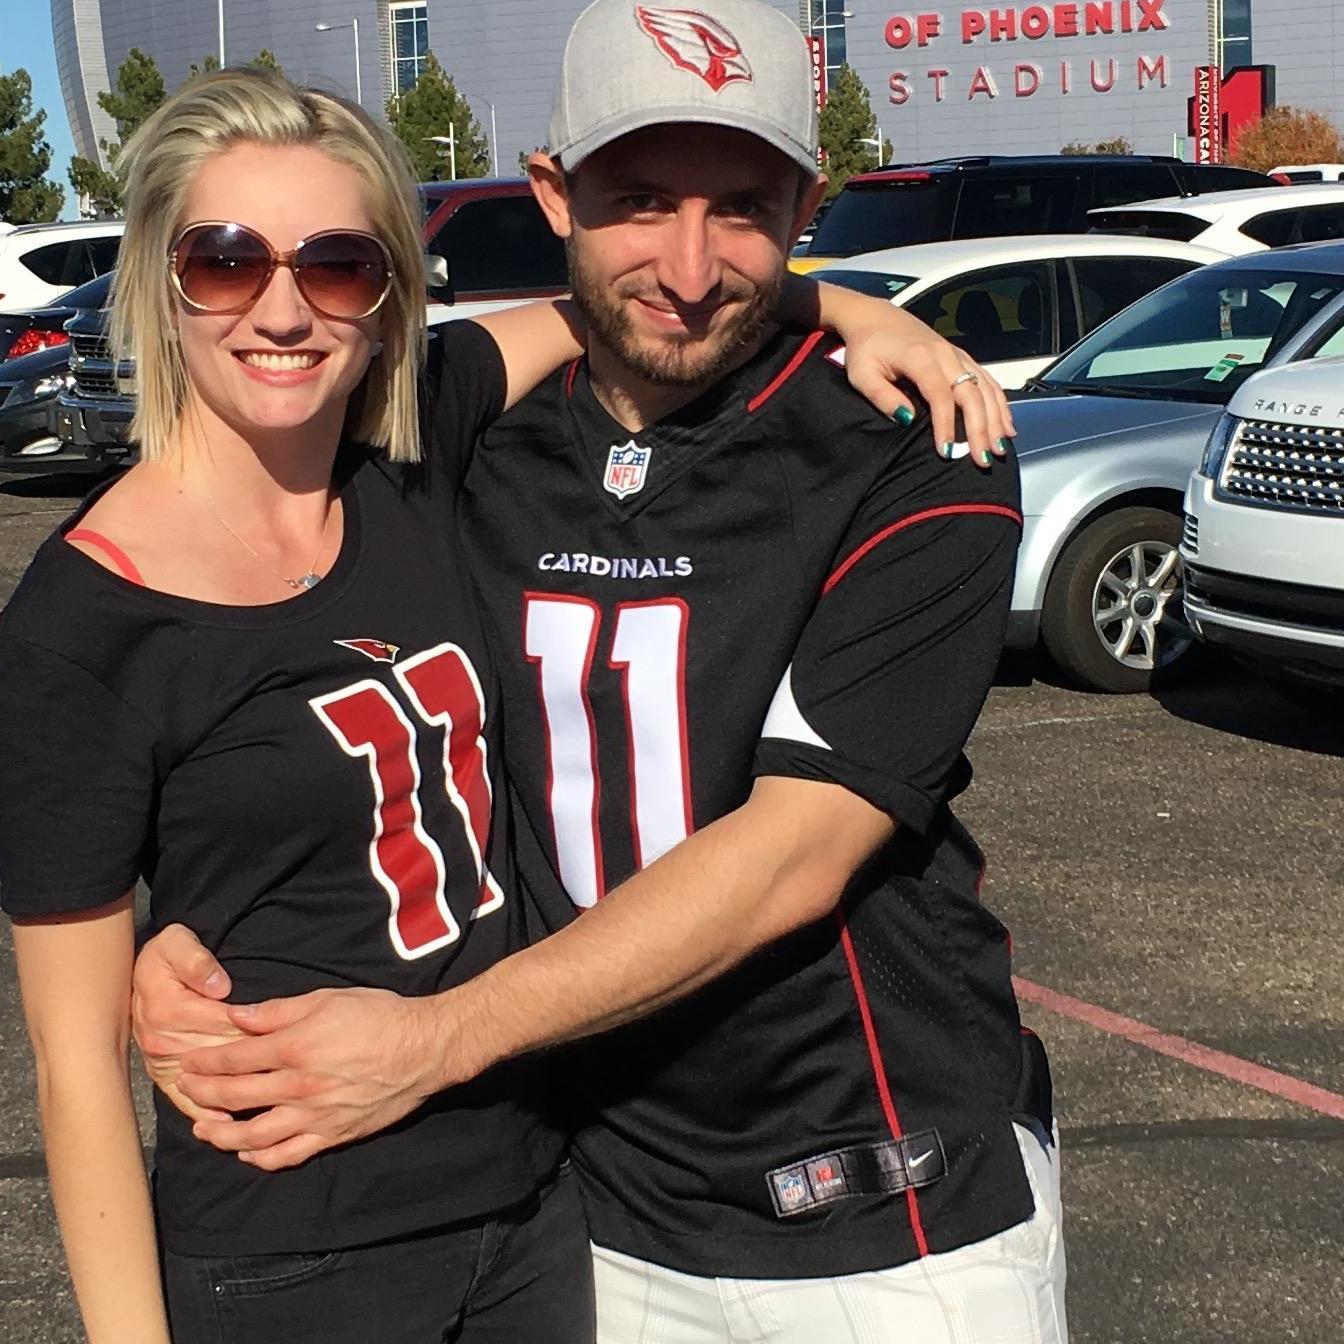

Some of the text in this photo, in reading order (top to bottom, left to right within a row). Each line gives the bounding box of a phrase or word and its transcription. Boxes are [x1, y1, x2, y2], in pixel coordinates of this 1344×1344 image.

[885, 13, 940, 49] OF
[889, 55, 1167, 105] STADIUM
[1255, 399, 1322, 417] RANGE
[609, 466, 640, 488] NFL
[538, 552, 694, 579] CARDINALS
[522, 591, 696, 916] 11
[308, 642, 504, 961] 11
